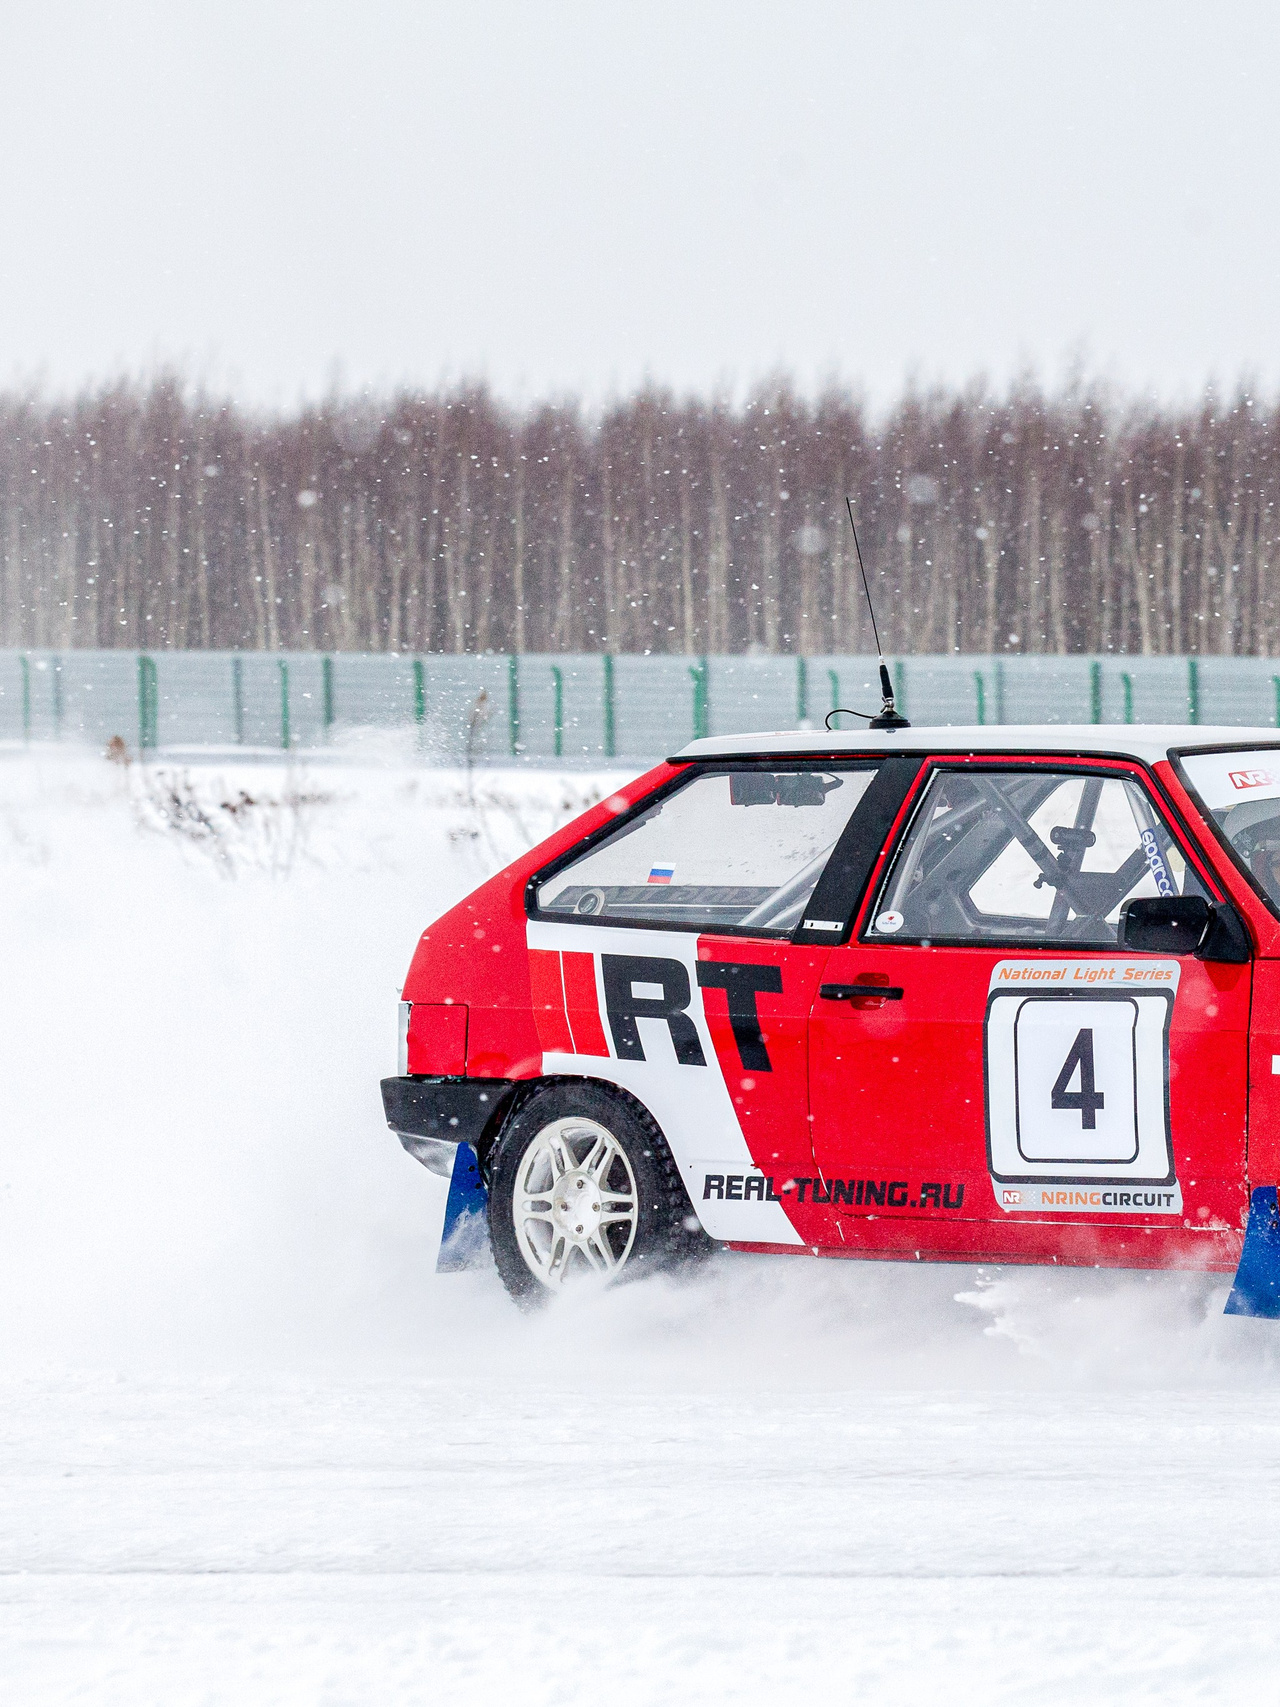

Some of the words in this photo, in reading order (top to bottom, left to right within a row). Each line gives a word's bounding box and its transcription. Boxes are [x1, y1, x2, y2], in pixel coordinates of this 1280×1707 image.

[998, 968, 1067, 980] National
[1073, 968, 1116, 982] Light
[1123, 968, 1173, 980] Series
[601, 953, 783, 1072] RT
[1051, 1028, 1104, 1129] 4
[703, 1174, 965, 1209] REAL-TUNING.RU
[1003, 1191, 1021, 1203] NR
[1042, 1191, 1174, 1207] NRINGCIRCUIT
